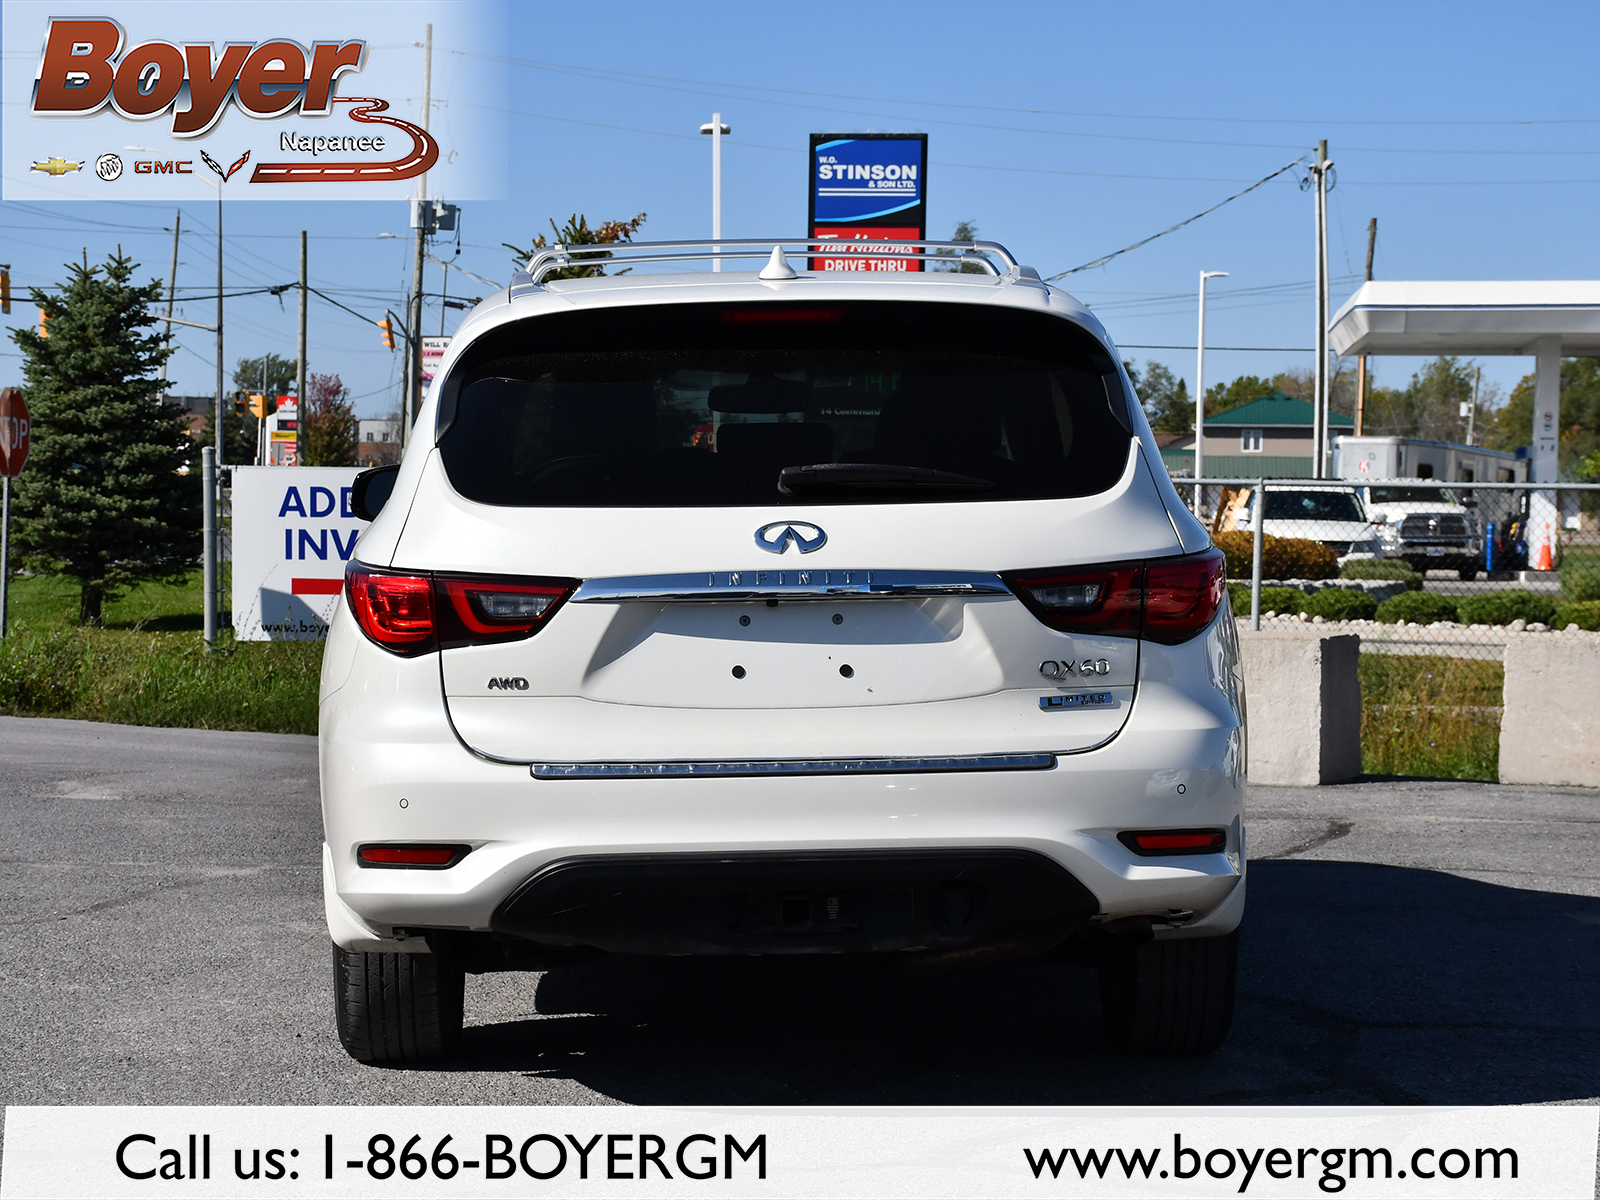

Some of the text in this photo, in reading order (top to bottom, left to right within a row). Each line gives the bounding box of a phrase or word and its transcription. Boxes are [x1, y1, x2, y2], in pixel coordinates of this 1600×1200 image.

[818, 156, 838, 164] W.O.
[818, 164, 917, 180] STINSON
[824, 259, 907, 271] DRIVE THRU
[708, 571, 874, 587] INFINITI
[1039, 658, 1110, 682] QX60
[487, 676, 530, 691] AWD
